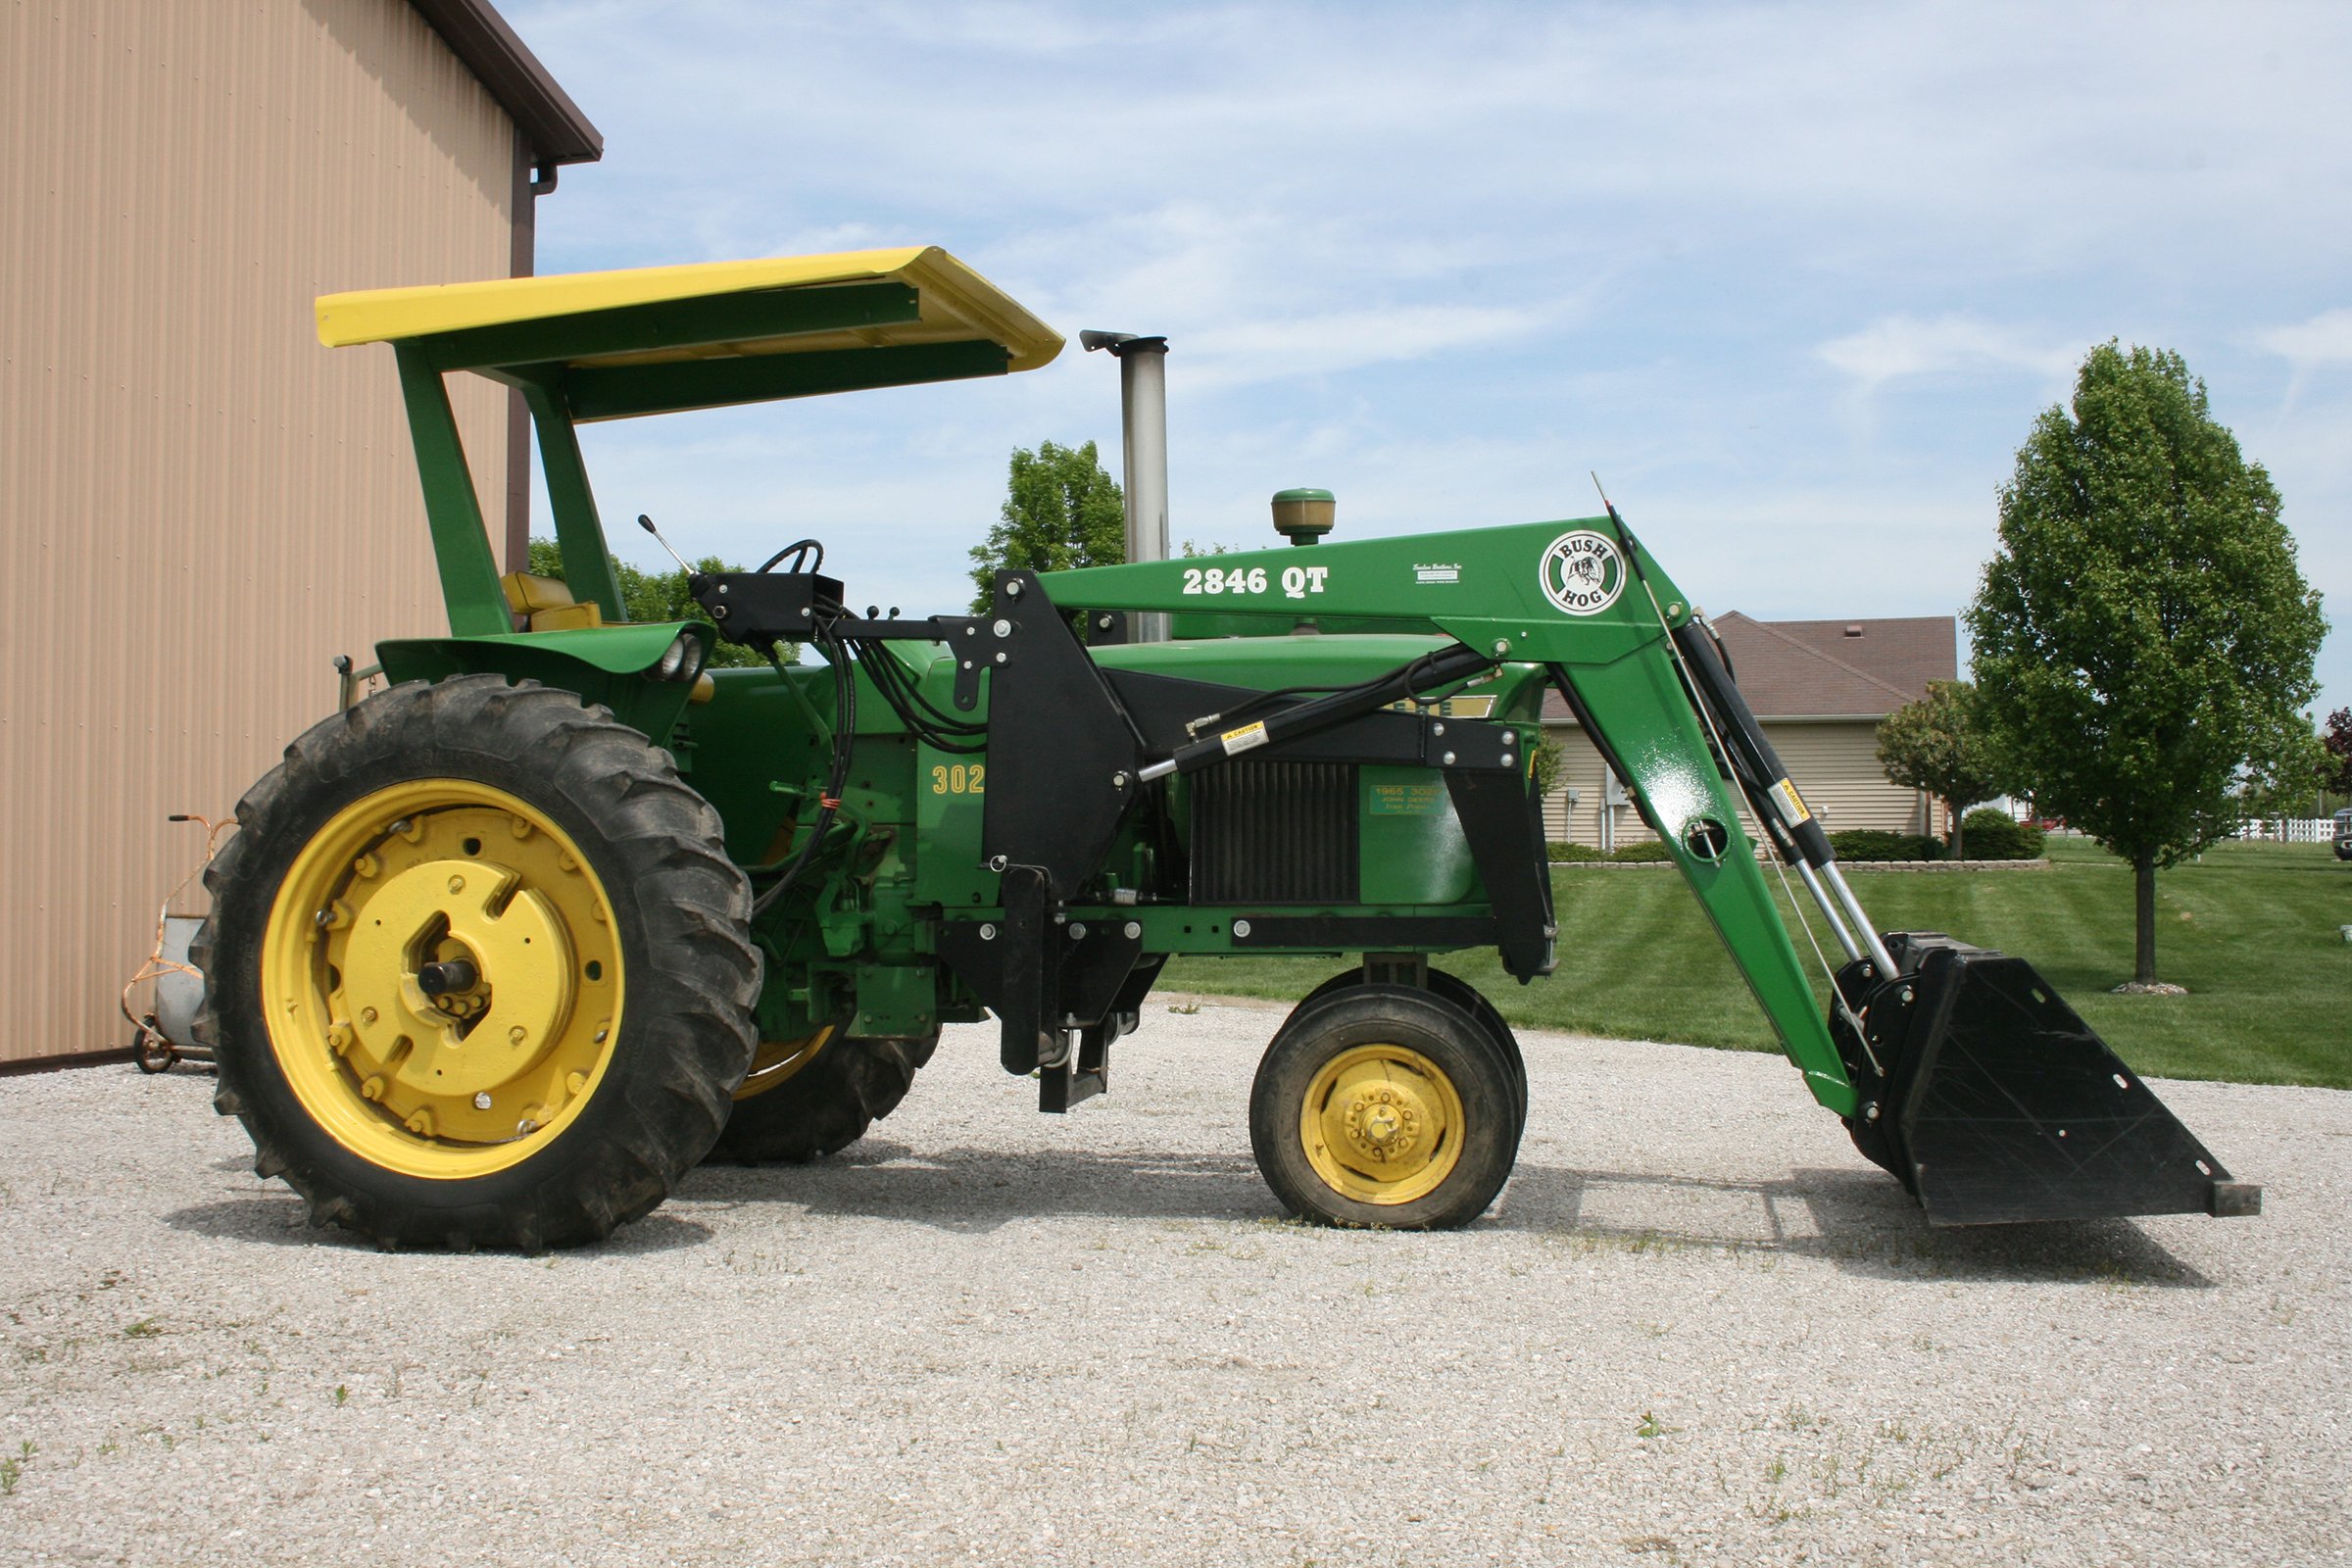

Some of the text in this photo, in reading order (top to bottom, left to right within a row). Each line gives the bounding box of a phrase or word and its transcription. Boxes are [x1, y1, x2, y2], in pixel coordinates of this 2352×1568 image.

[1559, 540, 1607, 559] BUSH
[1183, 566, 1328, 599] 2846 QT
[1562, 590, 1602, 607] HOG
[1234, 725, 1258, 736] CAUTION
[932, 764, 985, 794] 302
[1788, 791, 1805, 815] CAUTION
